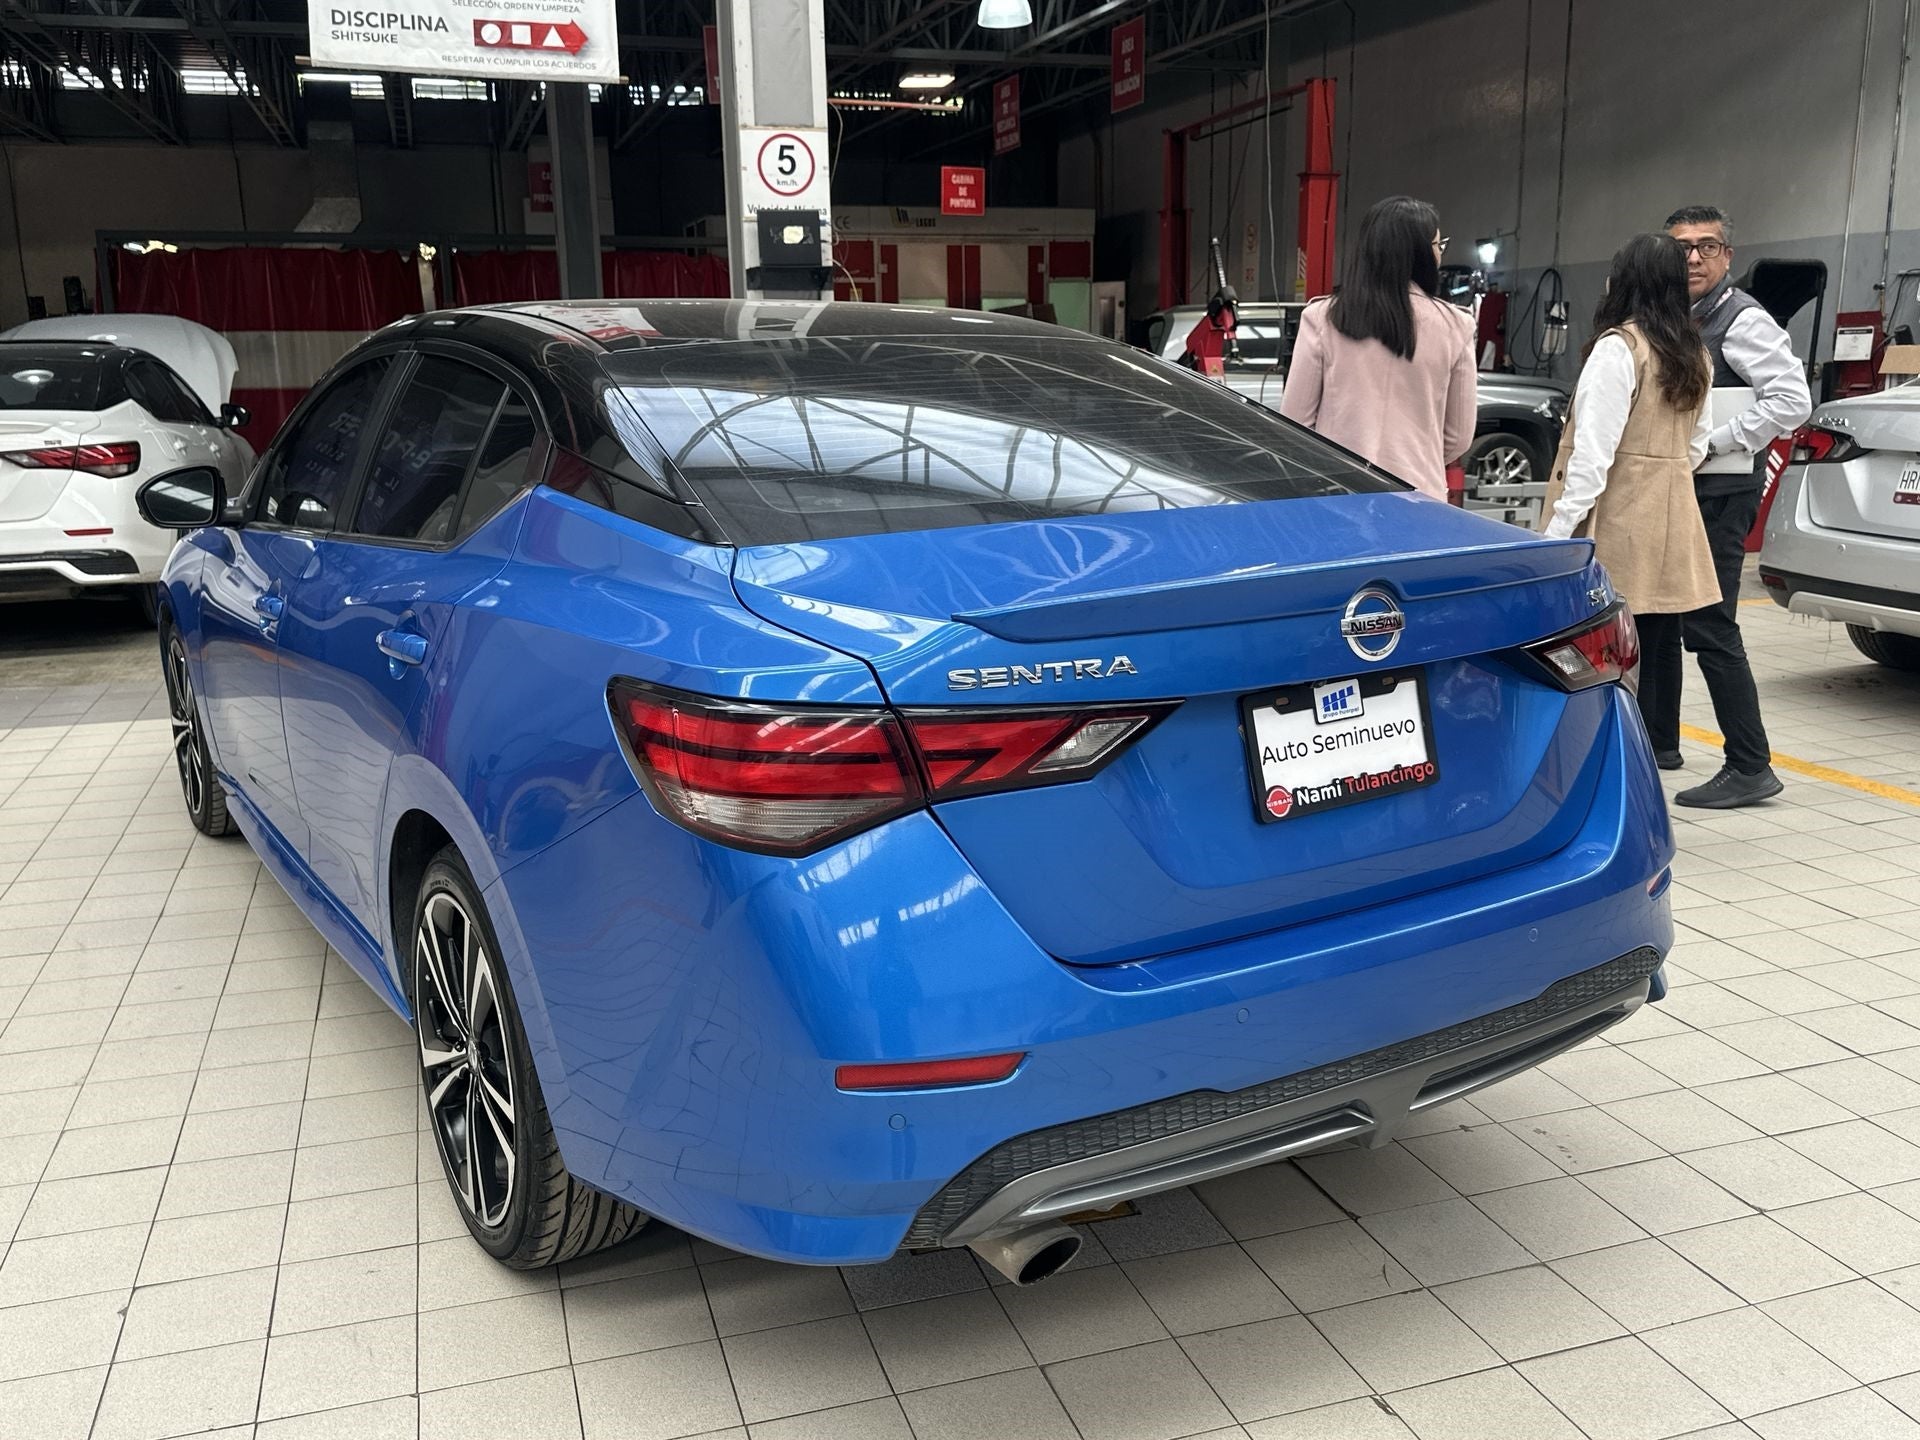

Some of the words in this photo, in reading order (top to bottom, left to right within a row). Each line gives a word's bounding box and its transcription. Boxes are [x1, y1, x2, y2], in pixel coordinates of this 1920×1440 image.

[504, 2, 534, 11] ORDEN
[331, 9, 449, 33] DISCIPLINA
[331, 30, 399, 44] SHITSUKE
[442, 55, 485, 64] RESPETAR
[486, 57, 492, 65] Y
[493, 57, 531, 67] CUMPLIR
[532, 59, 549, 67] LOS
[551, 60, 597, 70] ACUERDOS
[778, 144, 796, 175] 5
[949, 198, 977, 209] PINTURA
[1900, 470, 1920, 490] HR
[1350, 614, 1402, 633] NISSAN
[948, 655, 1139, 691] SENTRA
[1262, 741, 1308, 766] Auto
[1312, 718, 1416, 754] Seminuevo
[1296, 779, 1343, 806] Nami
[1344, 762, 1435, 794] Tulancingo
[1266, 796, 1293, 808] NISSAN
